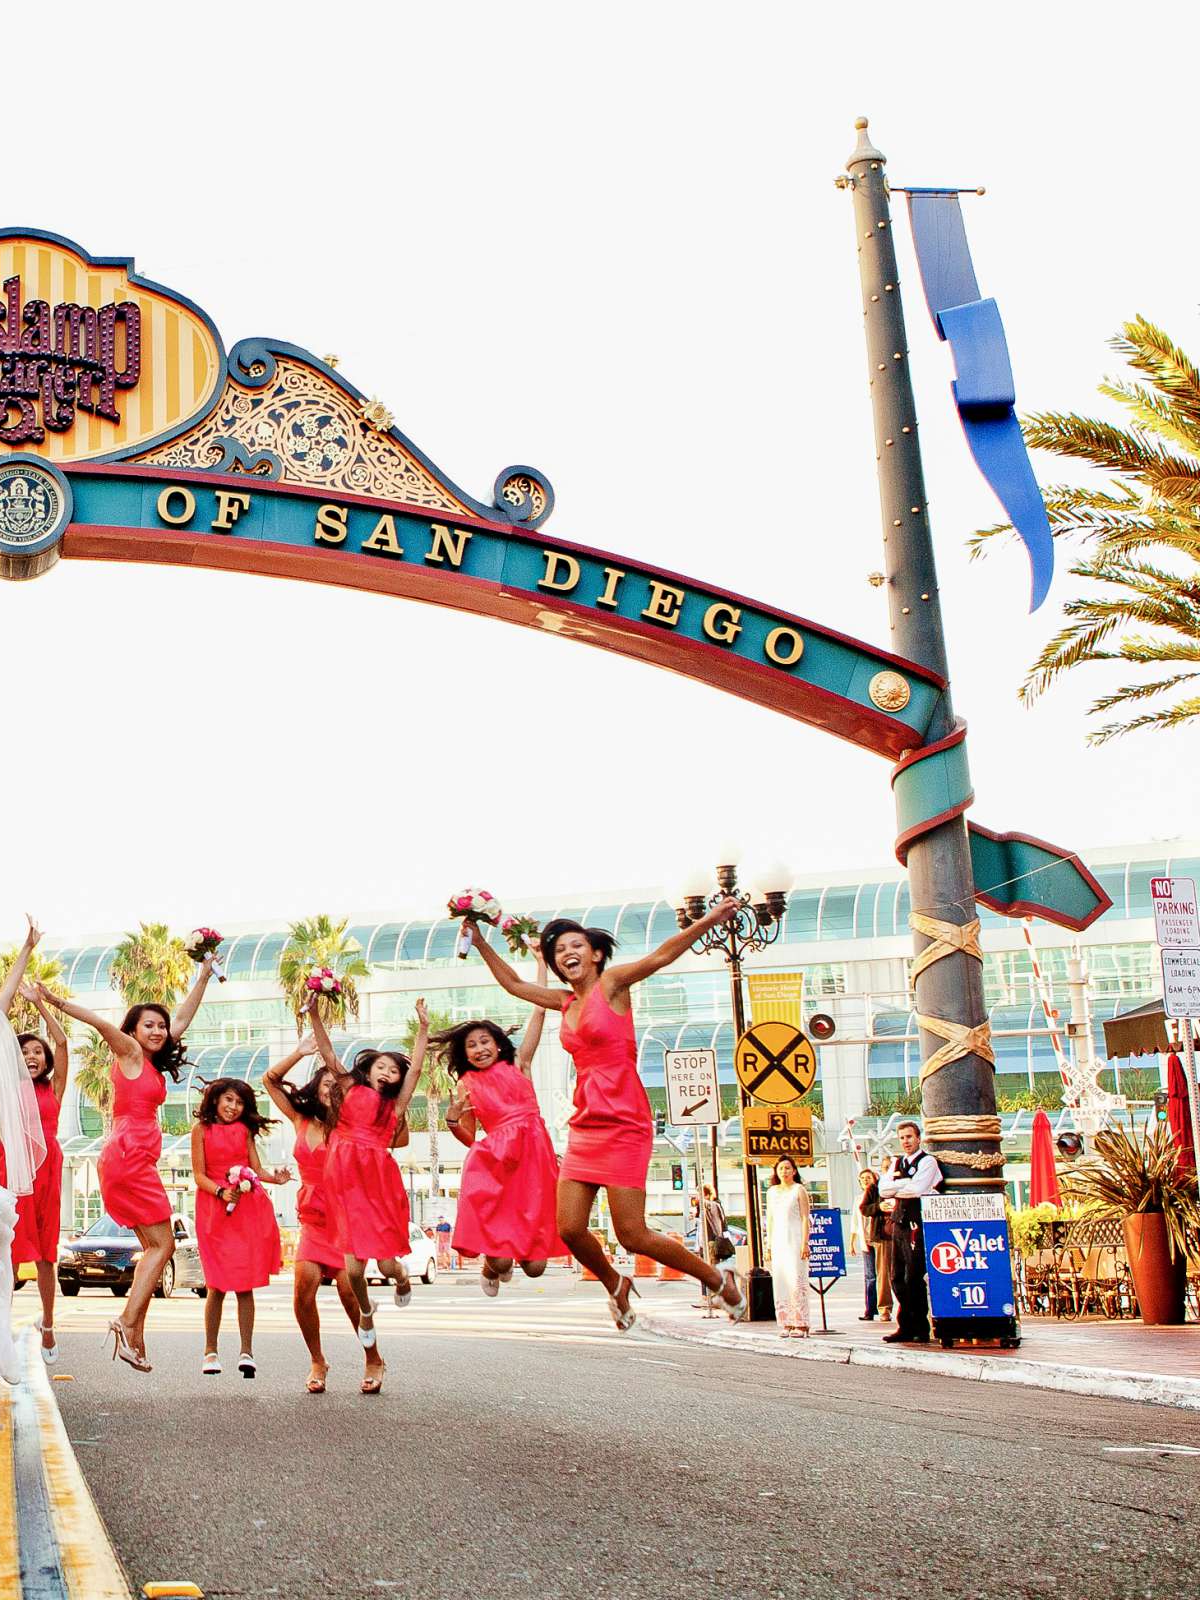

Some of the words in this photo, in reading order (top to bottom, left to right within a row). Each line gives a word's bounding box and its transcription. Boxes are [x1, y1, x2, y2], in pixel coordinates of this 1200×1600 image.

[157, 487, 250, 528] OF
[315, 504, 473, 566] SAN
[538, 550, 804, 666] DIEGO
[1155, 880, 1171, 896] NO
[1156, 902, 1195, 915] PARKING
[1164, 957, 1200, 966] COMMERCIAL
[1171, 969, 1196, 977] LOADING
[673, 1057, 707, 1069] STOP
[743, 1053, 758, 1072] R
[795, 1054, 810, 1073] R
[672, 1073, 695, 1081] HERE
[700, 1072, 712, 1080] ON
[772, 1115, 784, 1131] 3
[750, 1135, 809, 1151] TRACKS
[930, 1197, 967, 1208] PASSENGER
[968, 1196, 996, 1207] LOADING
[924, 1210, 943, 1220] VALET
[944, 1208, 972, 1219] PARKING
[973, 1207, 1006, 1219] OPTIONAL
[809, 1225, 825, 1234] ark
[949, 1228, 1006, 1253] Valet
[935, 1245, 989, 1270] Park
